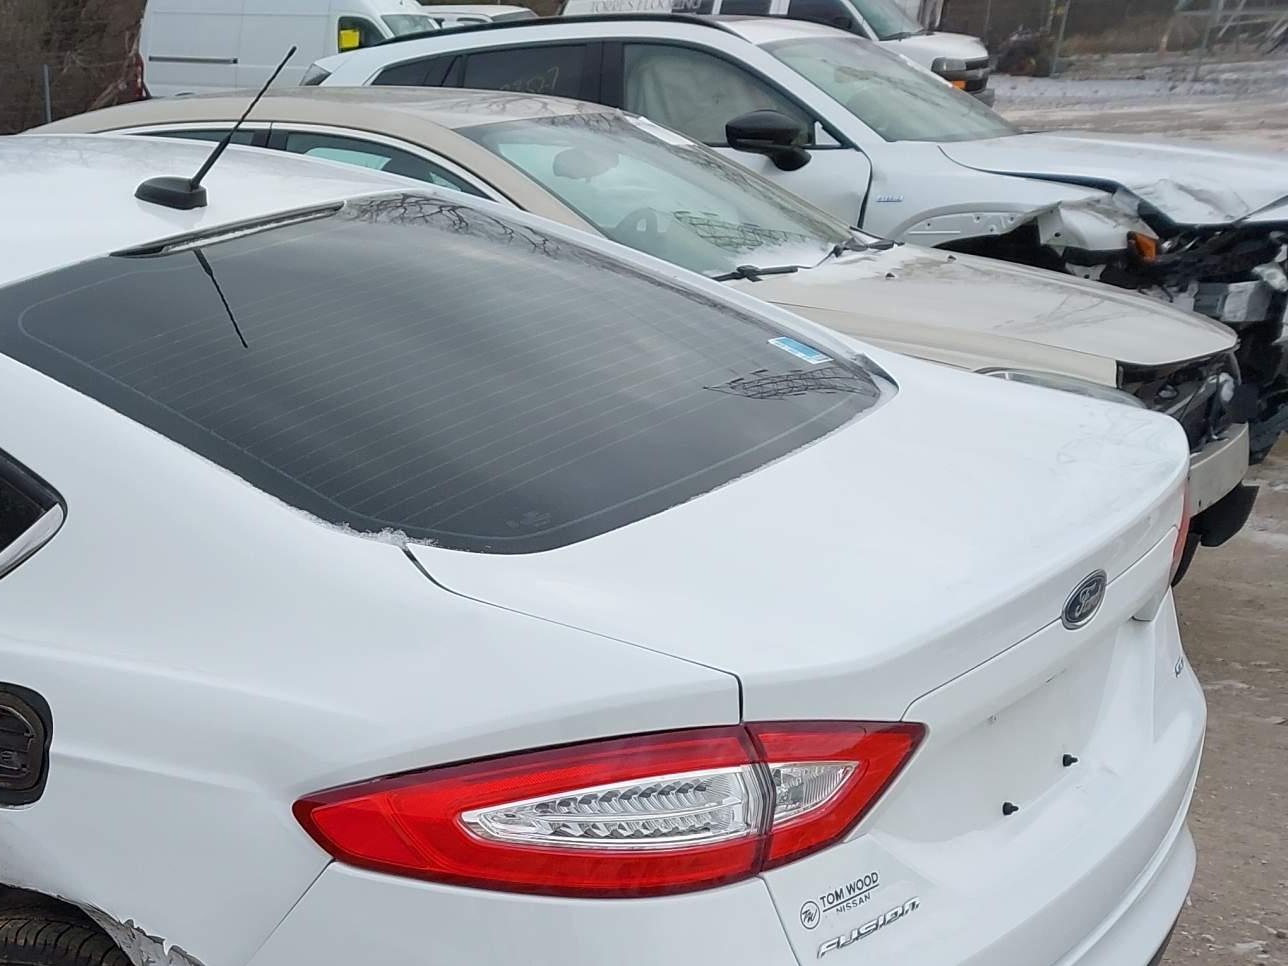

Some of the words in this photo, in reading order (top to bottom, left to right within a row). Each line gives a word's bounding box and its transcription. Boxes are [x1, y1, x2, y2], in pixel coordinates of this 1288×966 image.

[820, 888, 844, 907] TOM
[846, 872, 878, 893] WOOD
[836, 892, 871, 912] NISSAN
